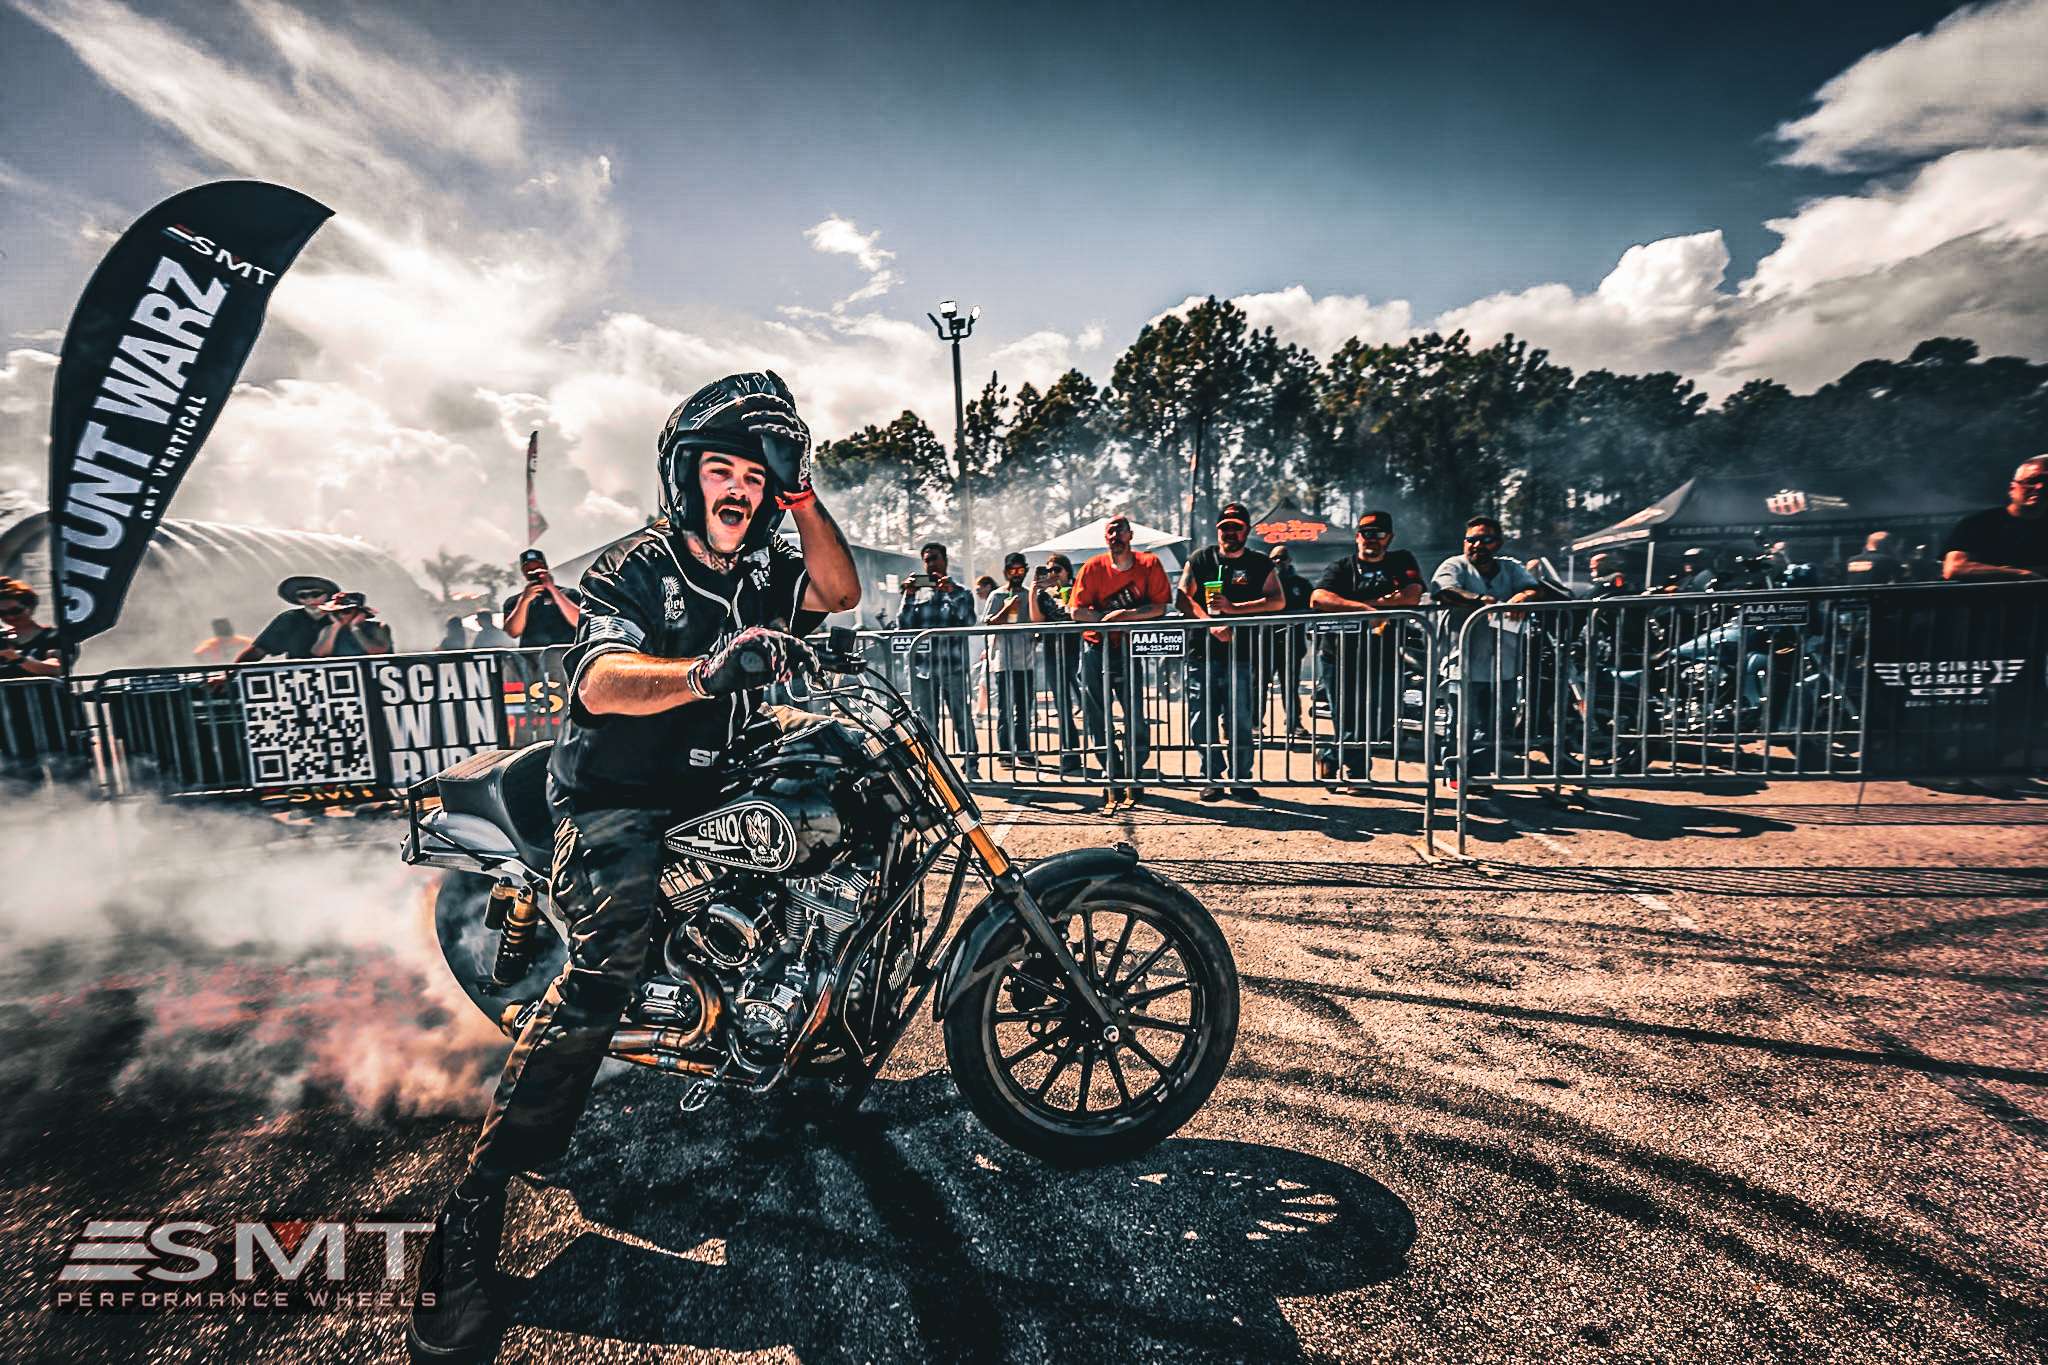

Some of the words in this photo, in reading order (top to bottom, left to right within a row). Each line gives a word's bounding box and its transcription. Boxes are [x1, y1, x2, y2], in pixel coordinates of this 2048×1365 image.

[190, 236, 276, 285] SMT
[94, 256, 229, 424] WARZ
[151, 396, 207, 477] VERTICAL
[1132, 633, 1158, 643] AAA
[1159, 633, 1183, 643] Fence
[379, 661, 492, 704] SCAN
[1906, 660, 1991, 673] ORGINAL
[1910, 673, 1983, 685] GARAGE
[382, 699, 498, 750] WIN
[389, 744, 499, 788] RI
[698, 813, 738, 844] GENO
